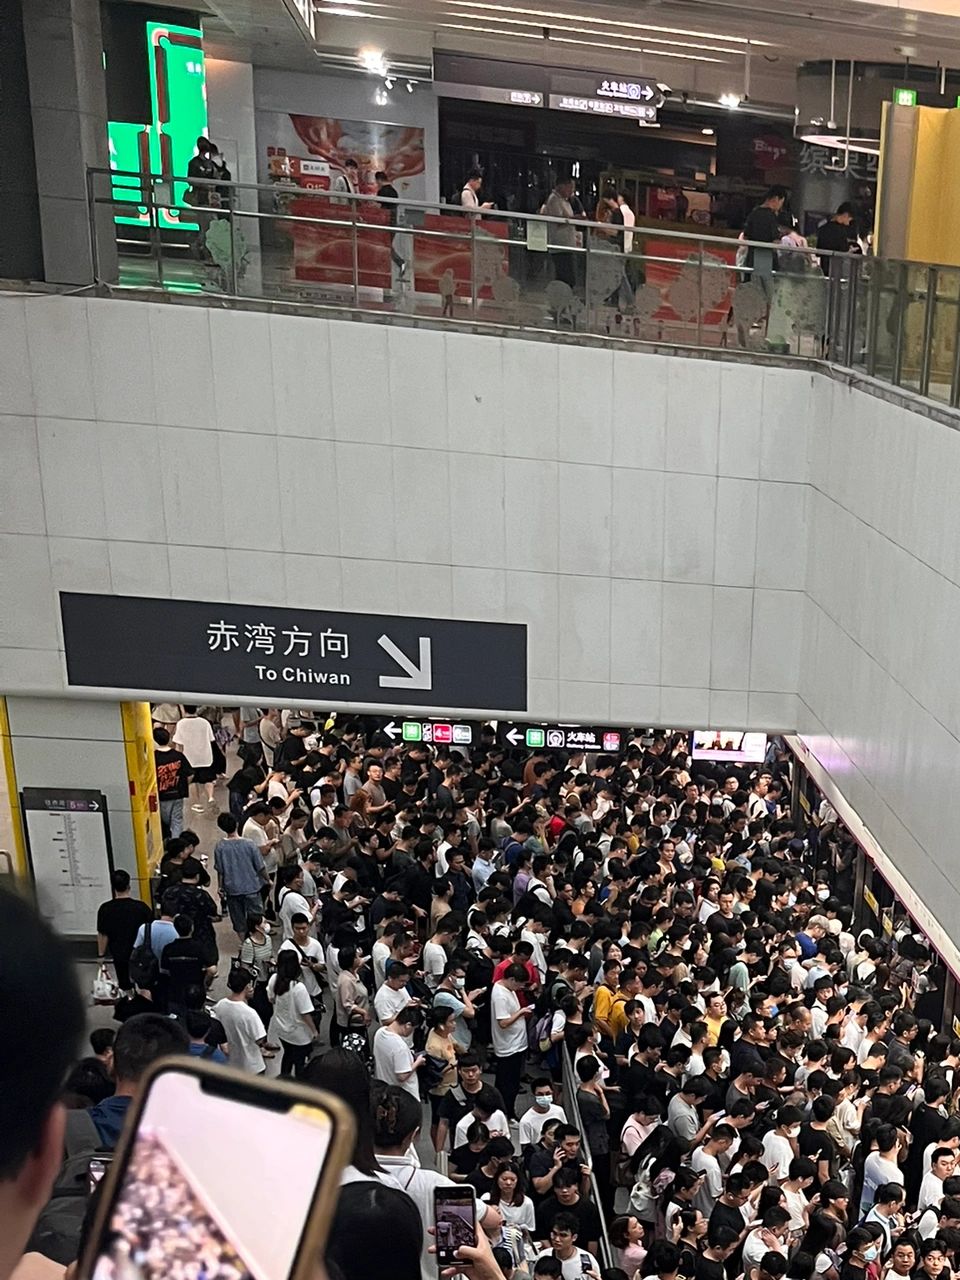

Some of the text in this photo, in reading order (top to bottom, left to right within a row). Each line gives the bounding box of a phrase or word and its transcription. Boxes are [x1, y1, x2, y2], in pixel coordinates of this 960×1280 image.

[207, 620, 350, 659] 赤湾方向
[255, 666, 350, 685] To Chiwan
[567, 732, 596, 743] 火车站
